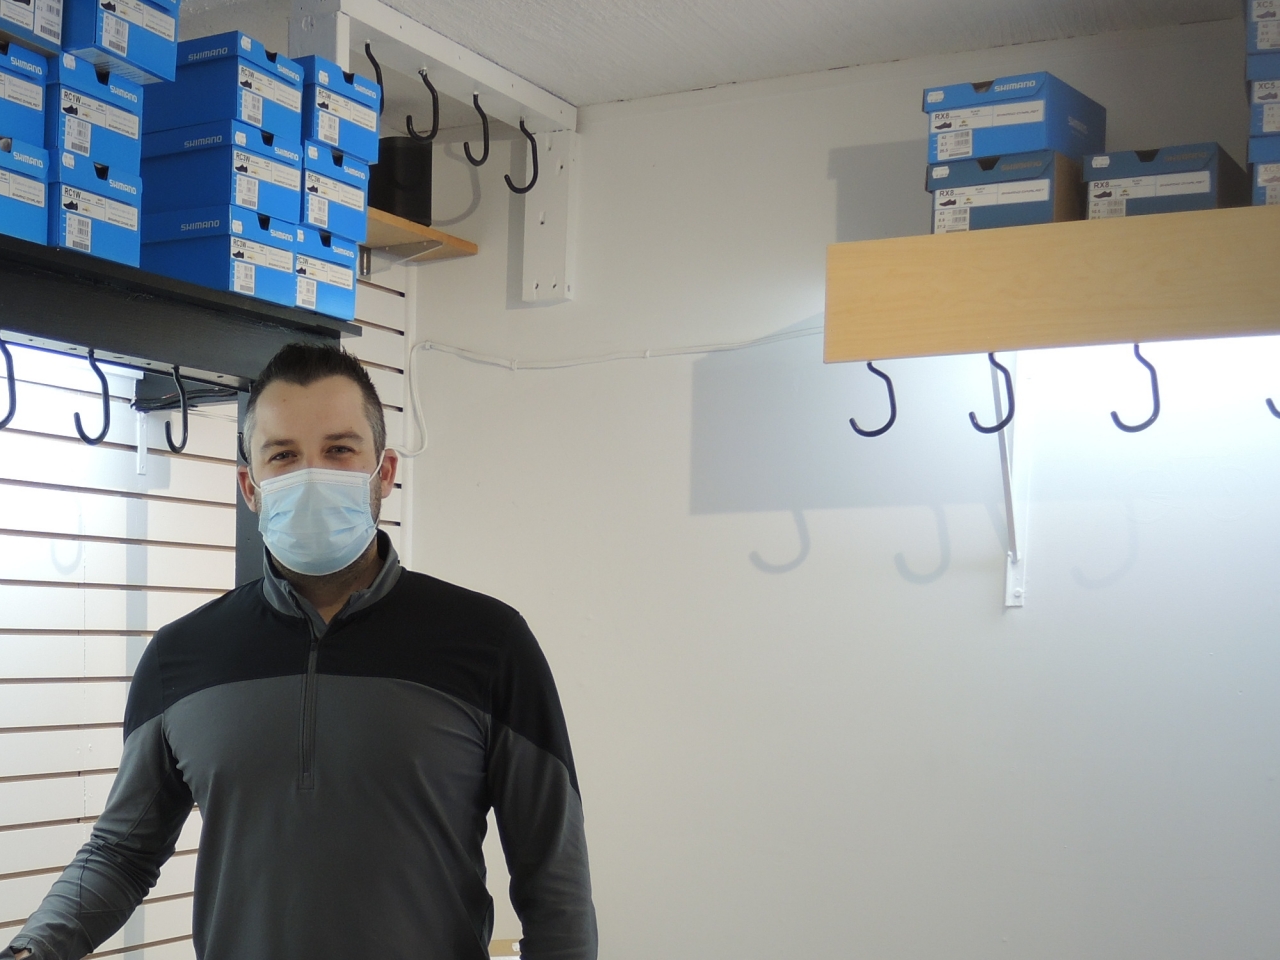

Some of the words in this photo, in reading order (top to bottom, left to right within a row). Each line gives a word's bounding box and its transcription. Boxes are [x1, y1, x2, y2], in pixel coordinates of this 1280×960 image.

[1256, 0, 1274, 9] XC5
[188, 47, 228, 62] SHIMANO
[10, 56, 42, 75] SHIMANO
[277, 63, 300, 82] SHIMANO
[354, 83, 377, 99] SHIMANO
[994, 80, 1036, 92] SHIMANO
[1258, 82, 1276, 90] XC5
[64, 90, 82, 104] RC1W
[110, 84, 138, 103] SHIMANO
[934, 112, 950, 120] RX8
[184, 135, 222, 148] SHIMANO
[13, 151, 44, 168] SHIMANO
[235, 151, 251, 163] RC3W
[274, 146, 299, 161] SHIMANO
[343, 165, 366, 180] SHIMANO
[108, 179, 137, 195] SHIMANO
[1093, 181, 1110, 189] RX8
[64, 186, 82, 199] RC1W
[180, 220, 220, 232] SHIMANO
[270, 229, 293, 242] SHIMANO
[332, 245, 354, 258] SHIMANO
